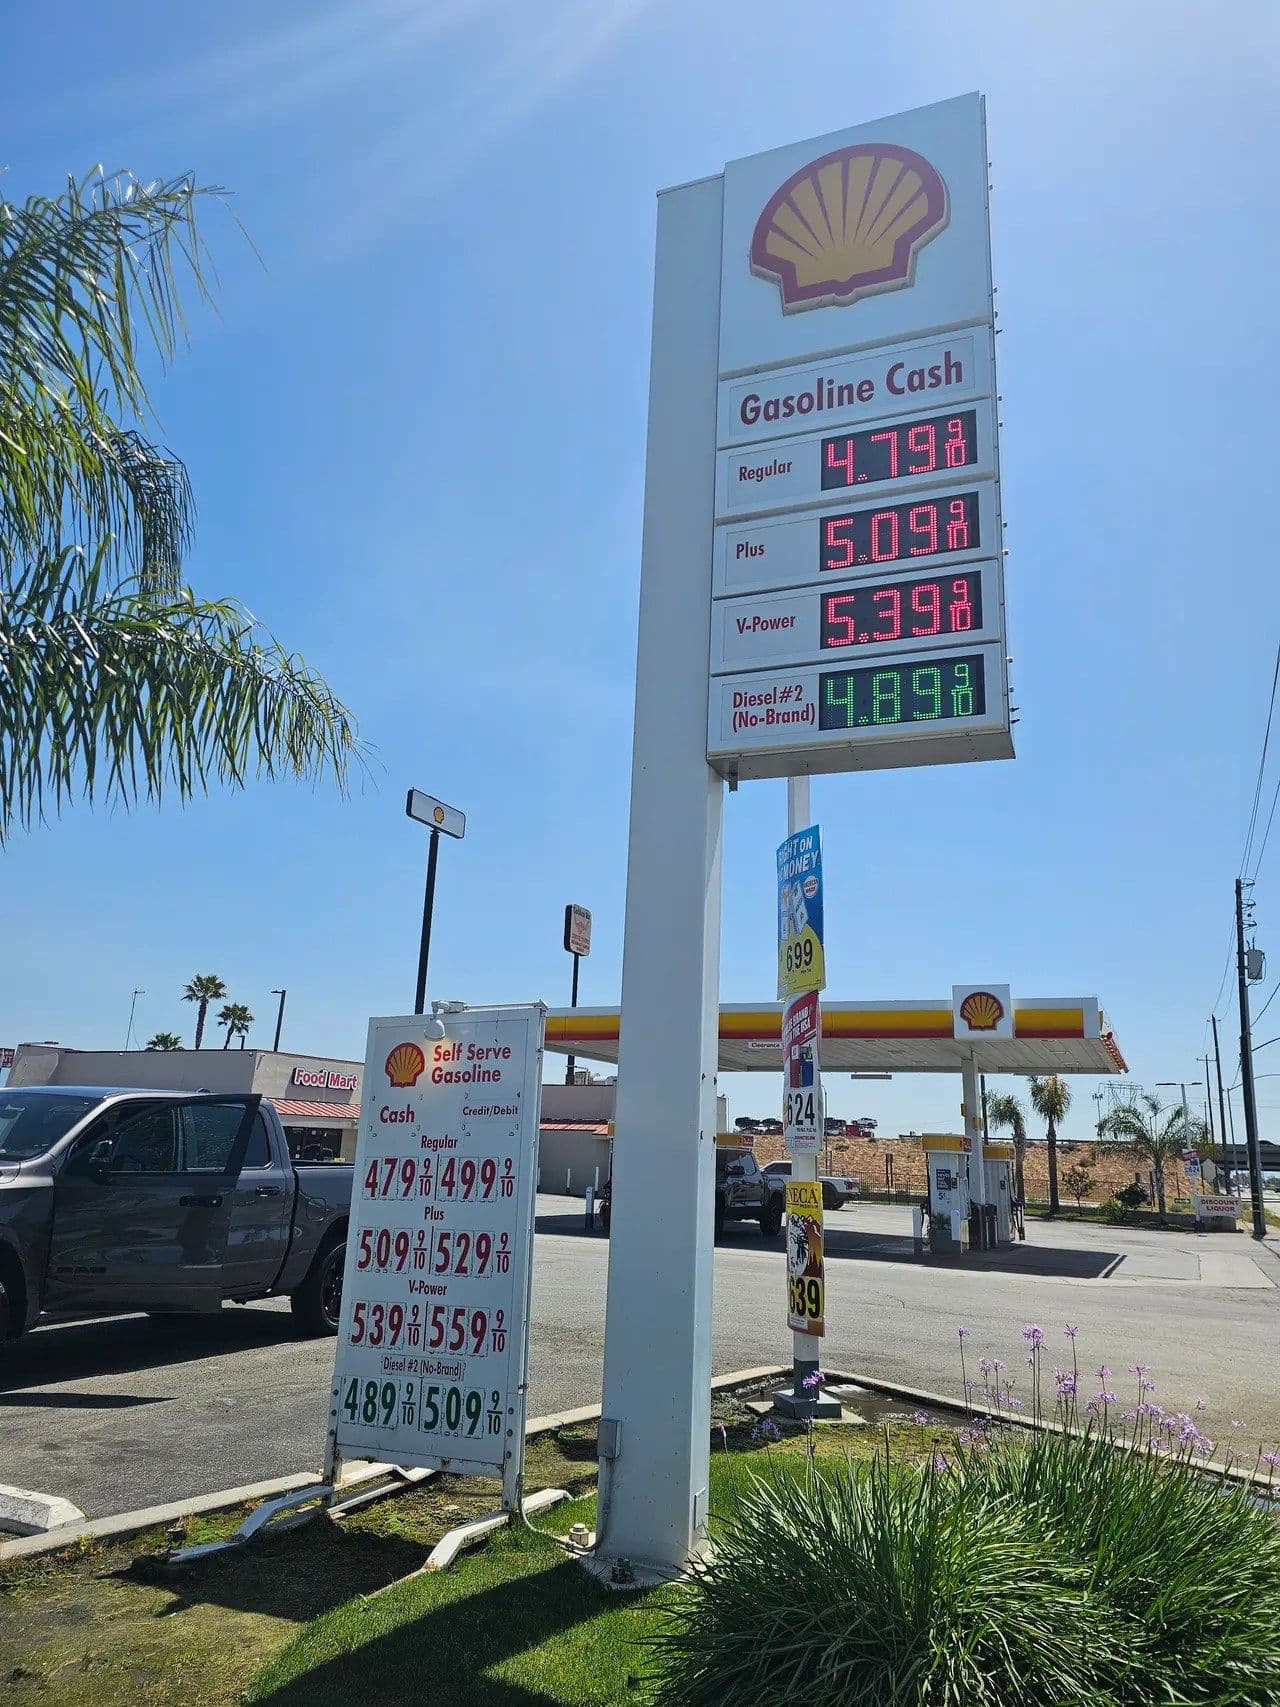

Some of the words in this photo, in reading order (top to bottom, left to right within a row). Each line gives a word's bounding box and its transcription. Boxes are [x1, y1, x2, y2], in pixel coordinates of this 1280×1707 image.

[740, 377, 876, 426] Gasoline
[886, 351, 963, 395] Cash
[738, 459, 793, 481] Regular
[736, 541, 765, 559] Plus
[736, 613, 796, 633] V-Power
[732, 703, 815, 733] (No-Brand)
[800, 836, 813, 852] ON
[433, 1043, 462, 1062] Self
[467, 1043, 511, 1061] Serve
[294, 1067, 328, 1088] Food
[328, 1072, 358, 1090] Mart
[432, 1064, 501, 1084] Gasoline
[380, 1104, 415, 1123] Cash
[462, 1105, 519, 1116] Credit/Debit
[421, 1134, 458, 1152] Regular
[424, 1206, 444, 1221] Plus
[408, 1280, 447, 1296] V-Power
[789, 1276, 820, 1319] 639
[384, 1357, 405, 1372] Diesel
[407, 1358, 418, 1370] #2
[420, 1360, 462, 1376] (No-Brand)
